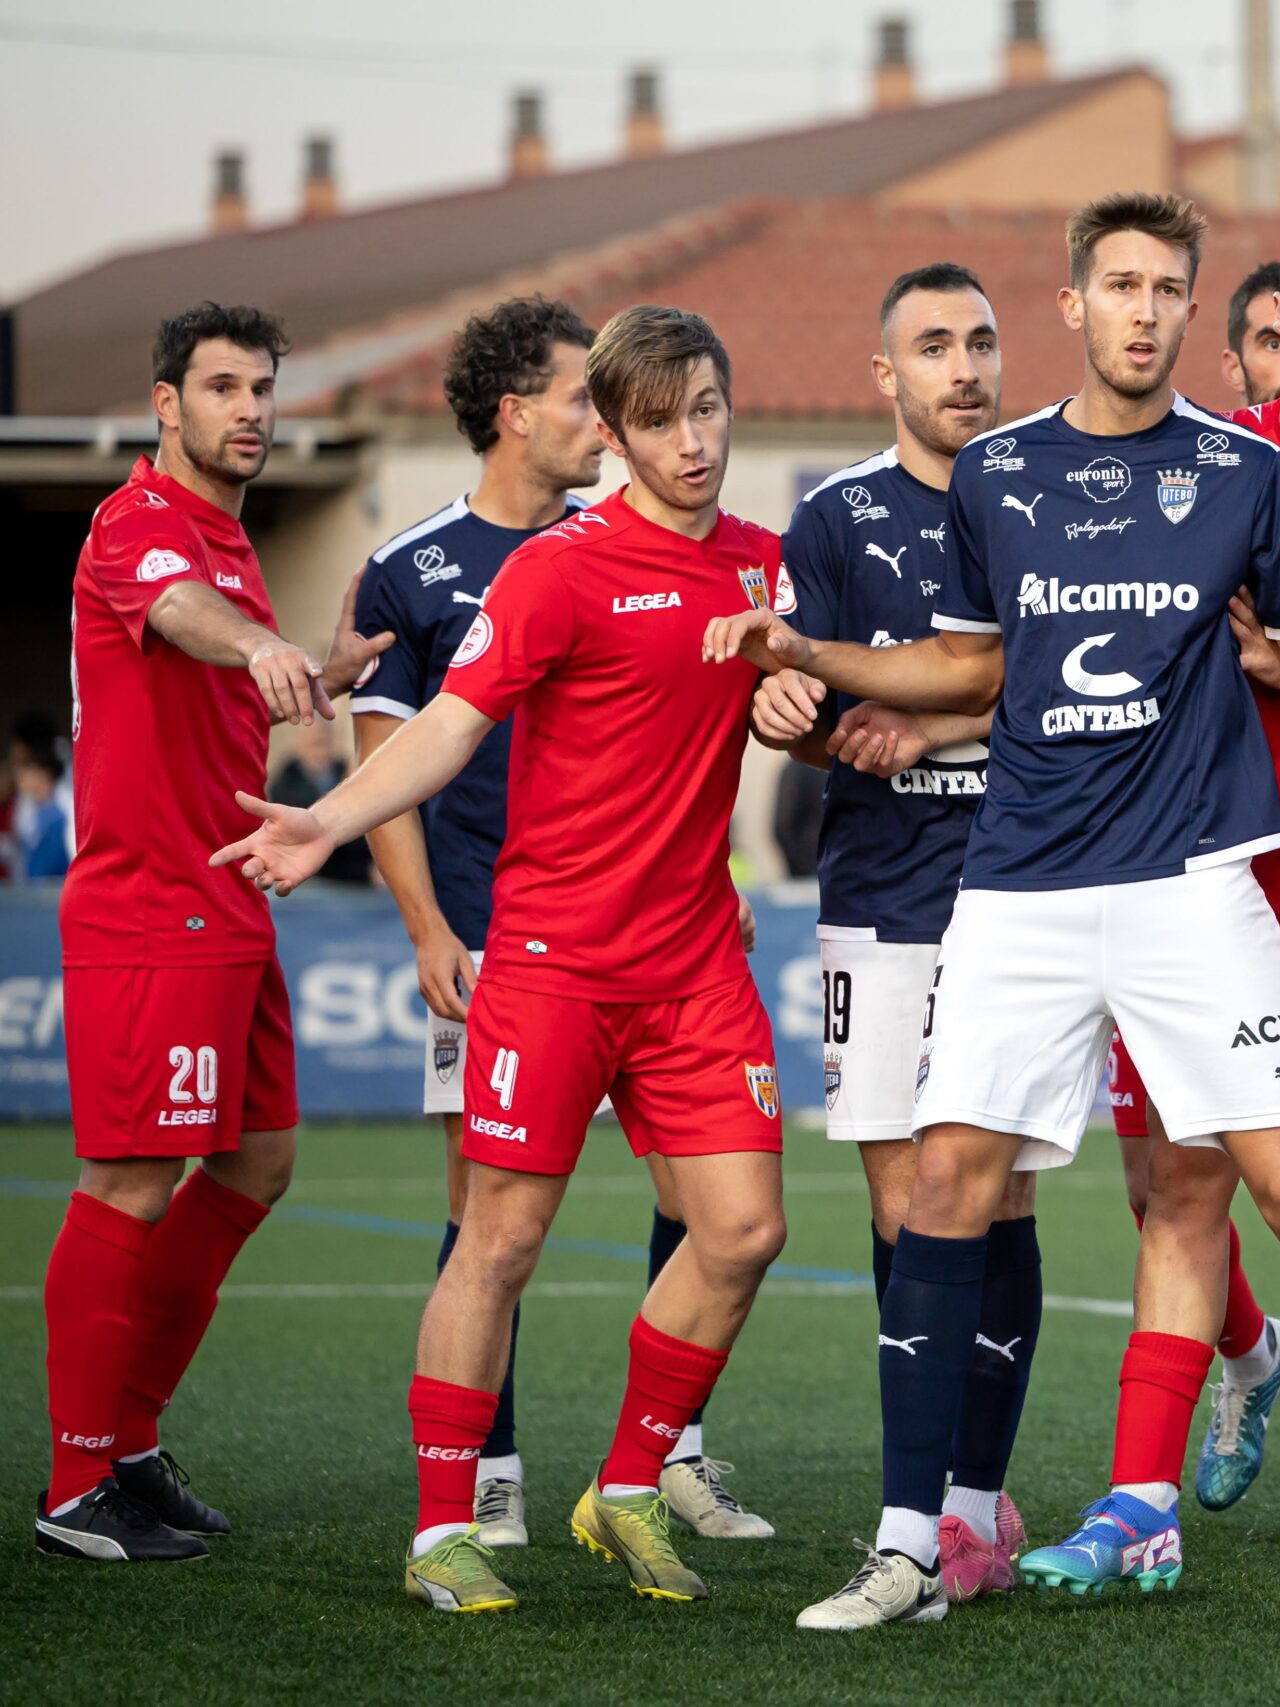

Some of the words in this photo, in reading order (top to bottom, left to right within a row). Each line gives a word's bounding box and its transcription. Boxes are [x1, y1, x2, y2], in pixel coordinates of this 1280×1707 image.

[983, 457, 1025, 467] SPHERE
[1066, 465, 1125, 482] euronix
[1103, 480, 1125, 490] sport
[1162, 488, 1193, 503] UTEBO
[612, 591, 682, 614] LEGEA
[1016, 572, 1200, 618] Alcampo
[1041, 697, 1161, 736] CINTASA
[823, 970, 852, 1044] 19
[168, 1045, 218, 1104] 20
[489, 1047, 520, 1111] 4
[157, 1108, 217, 1126] LEGEA
[470, 1113, 527, 1143] LEGEA
